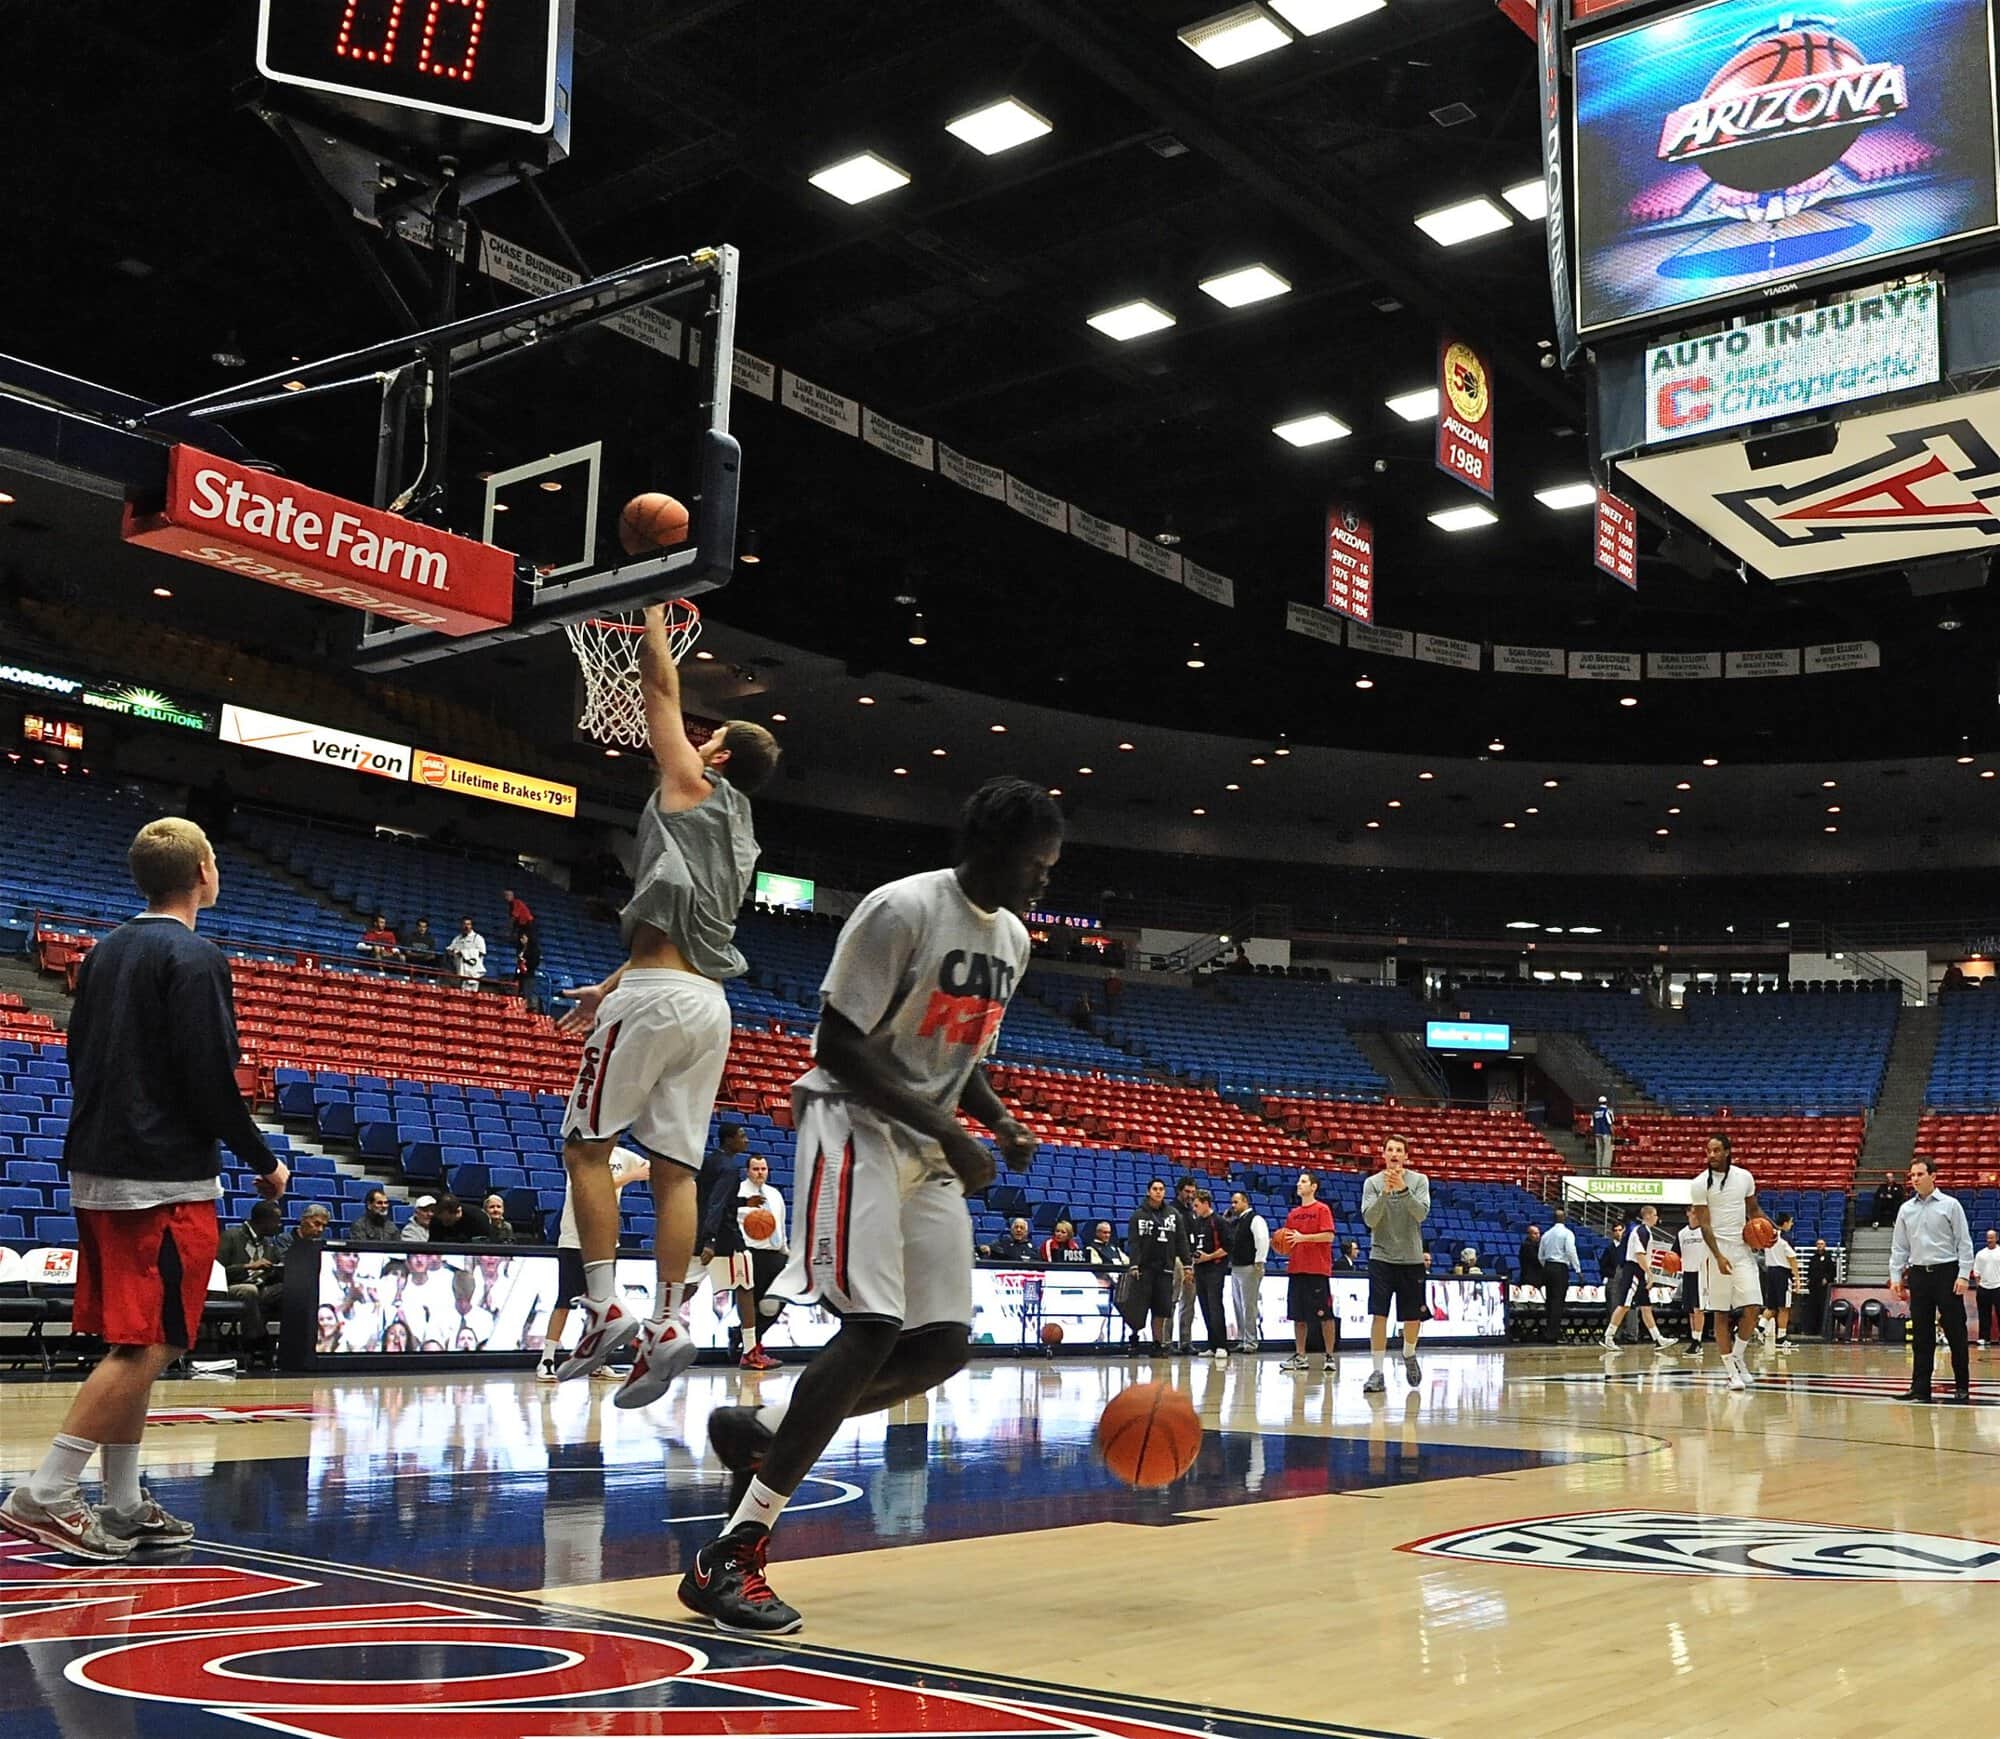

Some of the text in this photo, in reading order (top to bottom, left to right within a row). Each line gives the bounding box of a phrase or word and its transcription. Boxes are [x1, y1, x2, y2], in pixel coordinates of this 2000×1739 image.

[1668, 66, 1905, 153] ARIZONA
[489, 238, 574, 286] CHASE BUDINGER
[506, 261, 562, 291] BASKETBAL
[1763, 282, 1798, 297] VIACOM
[1652, 284, 1934, 374] AUTO INJURY?
[1443, 416, 1489, 453] ARIZONA
[1450, 444, 1482, 478] 1988
[1600, 503, 1632, 532] SWEET 16
[1331, 527, 1370, 554] ARIZONA
[1600, 520, 1633, 549] 1997 1998
[1332, 549, 1368, 575] SWEET 16
[1600, 535, 1632, 564] 2001 2002
[1332, 565, 1369, 590] 1976 1988
[1600, 550, 1632, 579] 2003 2005
[1332, 594, 1369, 618] 1994 1996
[1352, 589, 1368, 603] 1991
[82, 693, 204, 730] BRIGHT SOLUTIONS
[312, 738, 403, 775] verizon
[451, 769, 499, 792] Lifetime
[502, 781, 542, 802] Brakes
[305, 958, 313, 970] 3
[576, 1046, 600, 1110] CATS
[1590, 1181, 1661, 1194] SUNSTREET
[45, 1251, 73, 1270] 2K
[1063, 1249, 1086, 1262] POSS.
[43, 1270, 70, 1278] SPORTS
